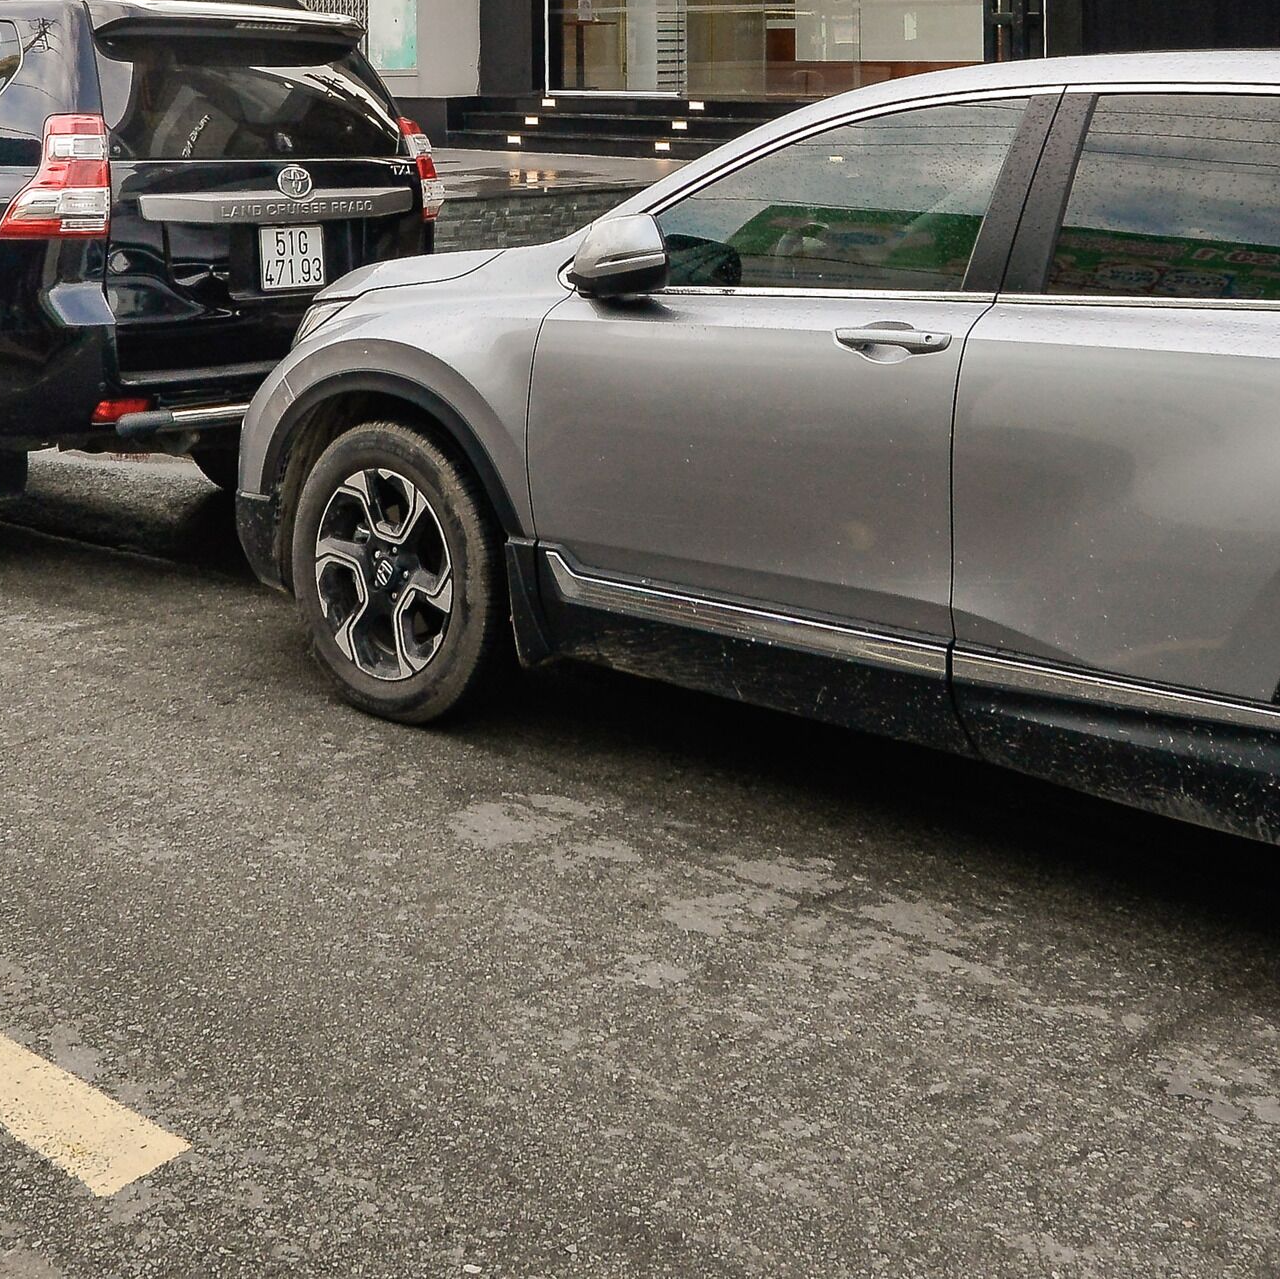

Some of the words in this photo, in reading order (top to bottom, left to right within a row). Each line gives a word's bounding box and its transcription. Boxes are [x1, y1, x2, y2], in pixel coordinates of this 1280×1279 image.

[221, 204, 262, 218] LAND
[266, 201, 327, 216] CRUISER
[331, 200, 374, 213] PRADO
[276, 230, 309, 256] 51G
[264, 257, 323, 286] 471.93
